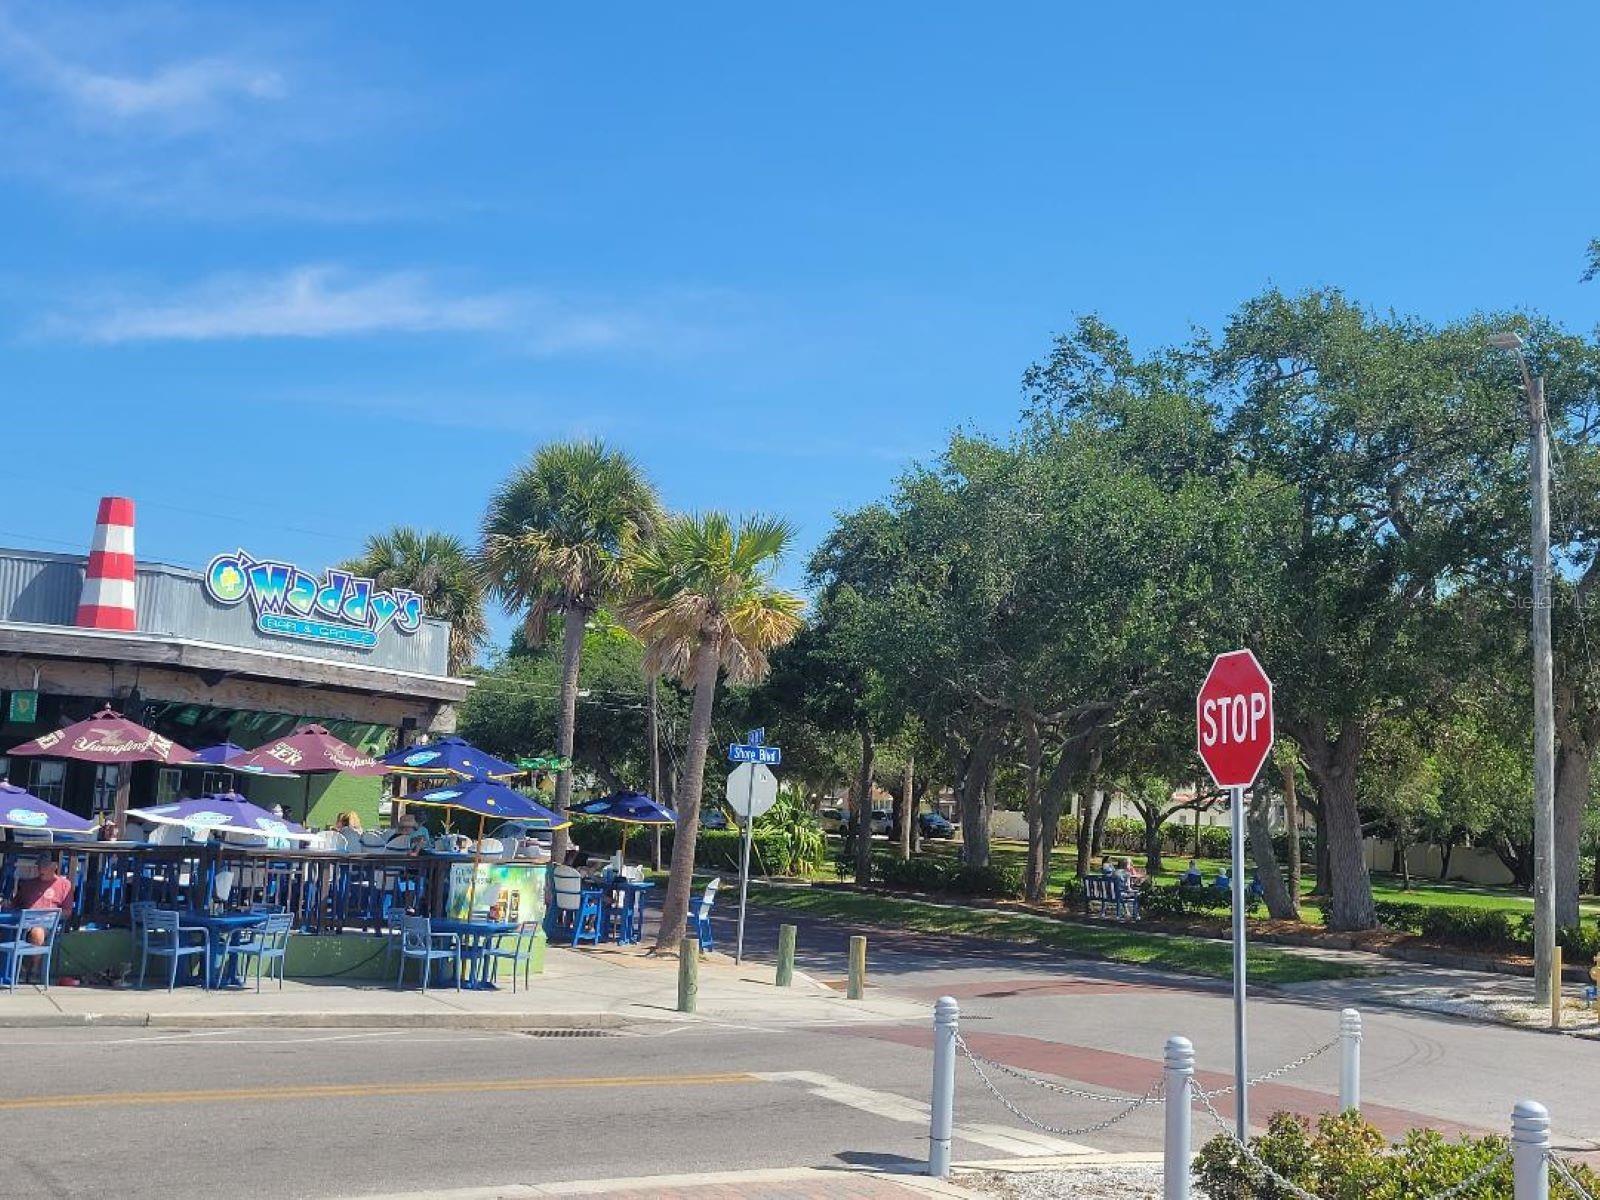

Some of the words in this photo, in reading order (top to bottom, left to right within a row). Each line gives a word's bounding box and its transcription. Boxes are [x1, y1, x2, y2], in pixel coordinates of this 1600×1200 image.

[205, 547, 423, 637] O'Maddy's
[266, 618, 297, 631] BAR
[1203, 692, 1266, 747] STOP
[733, 747, 756, 761] Shore
